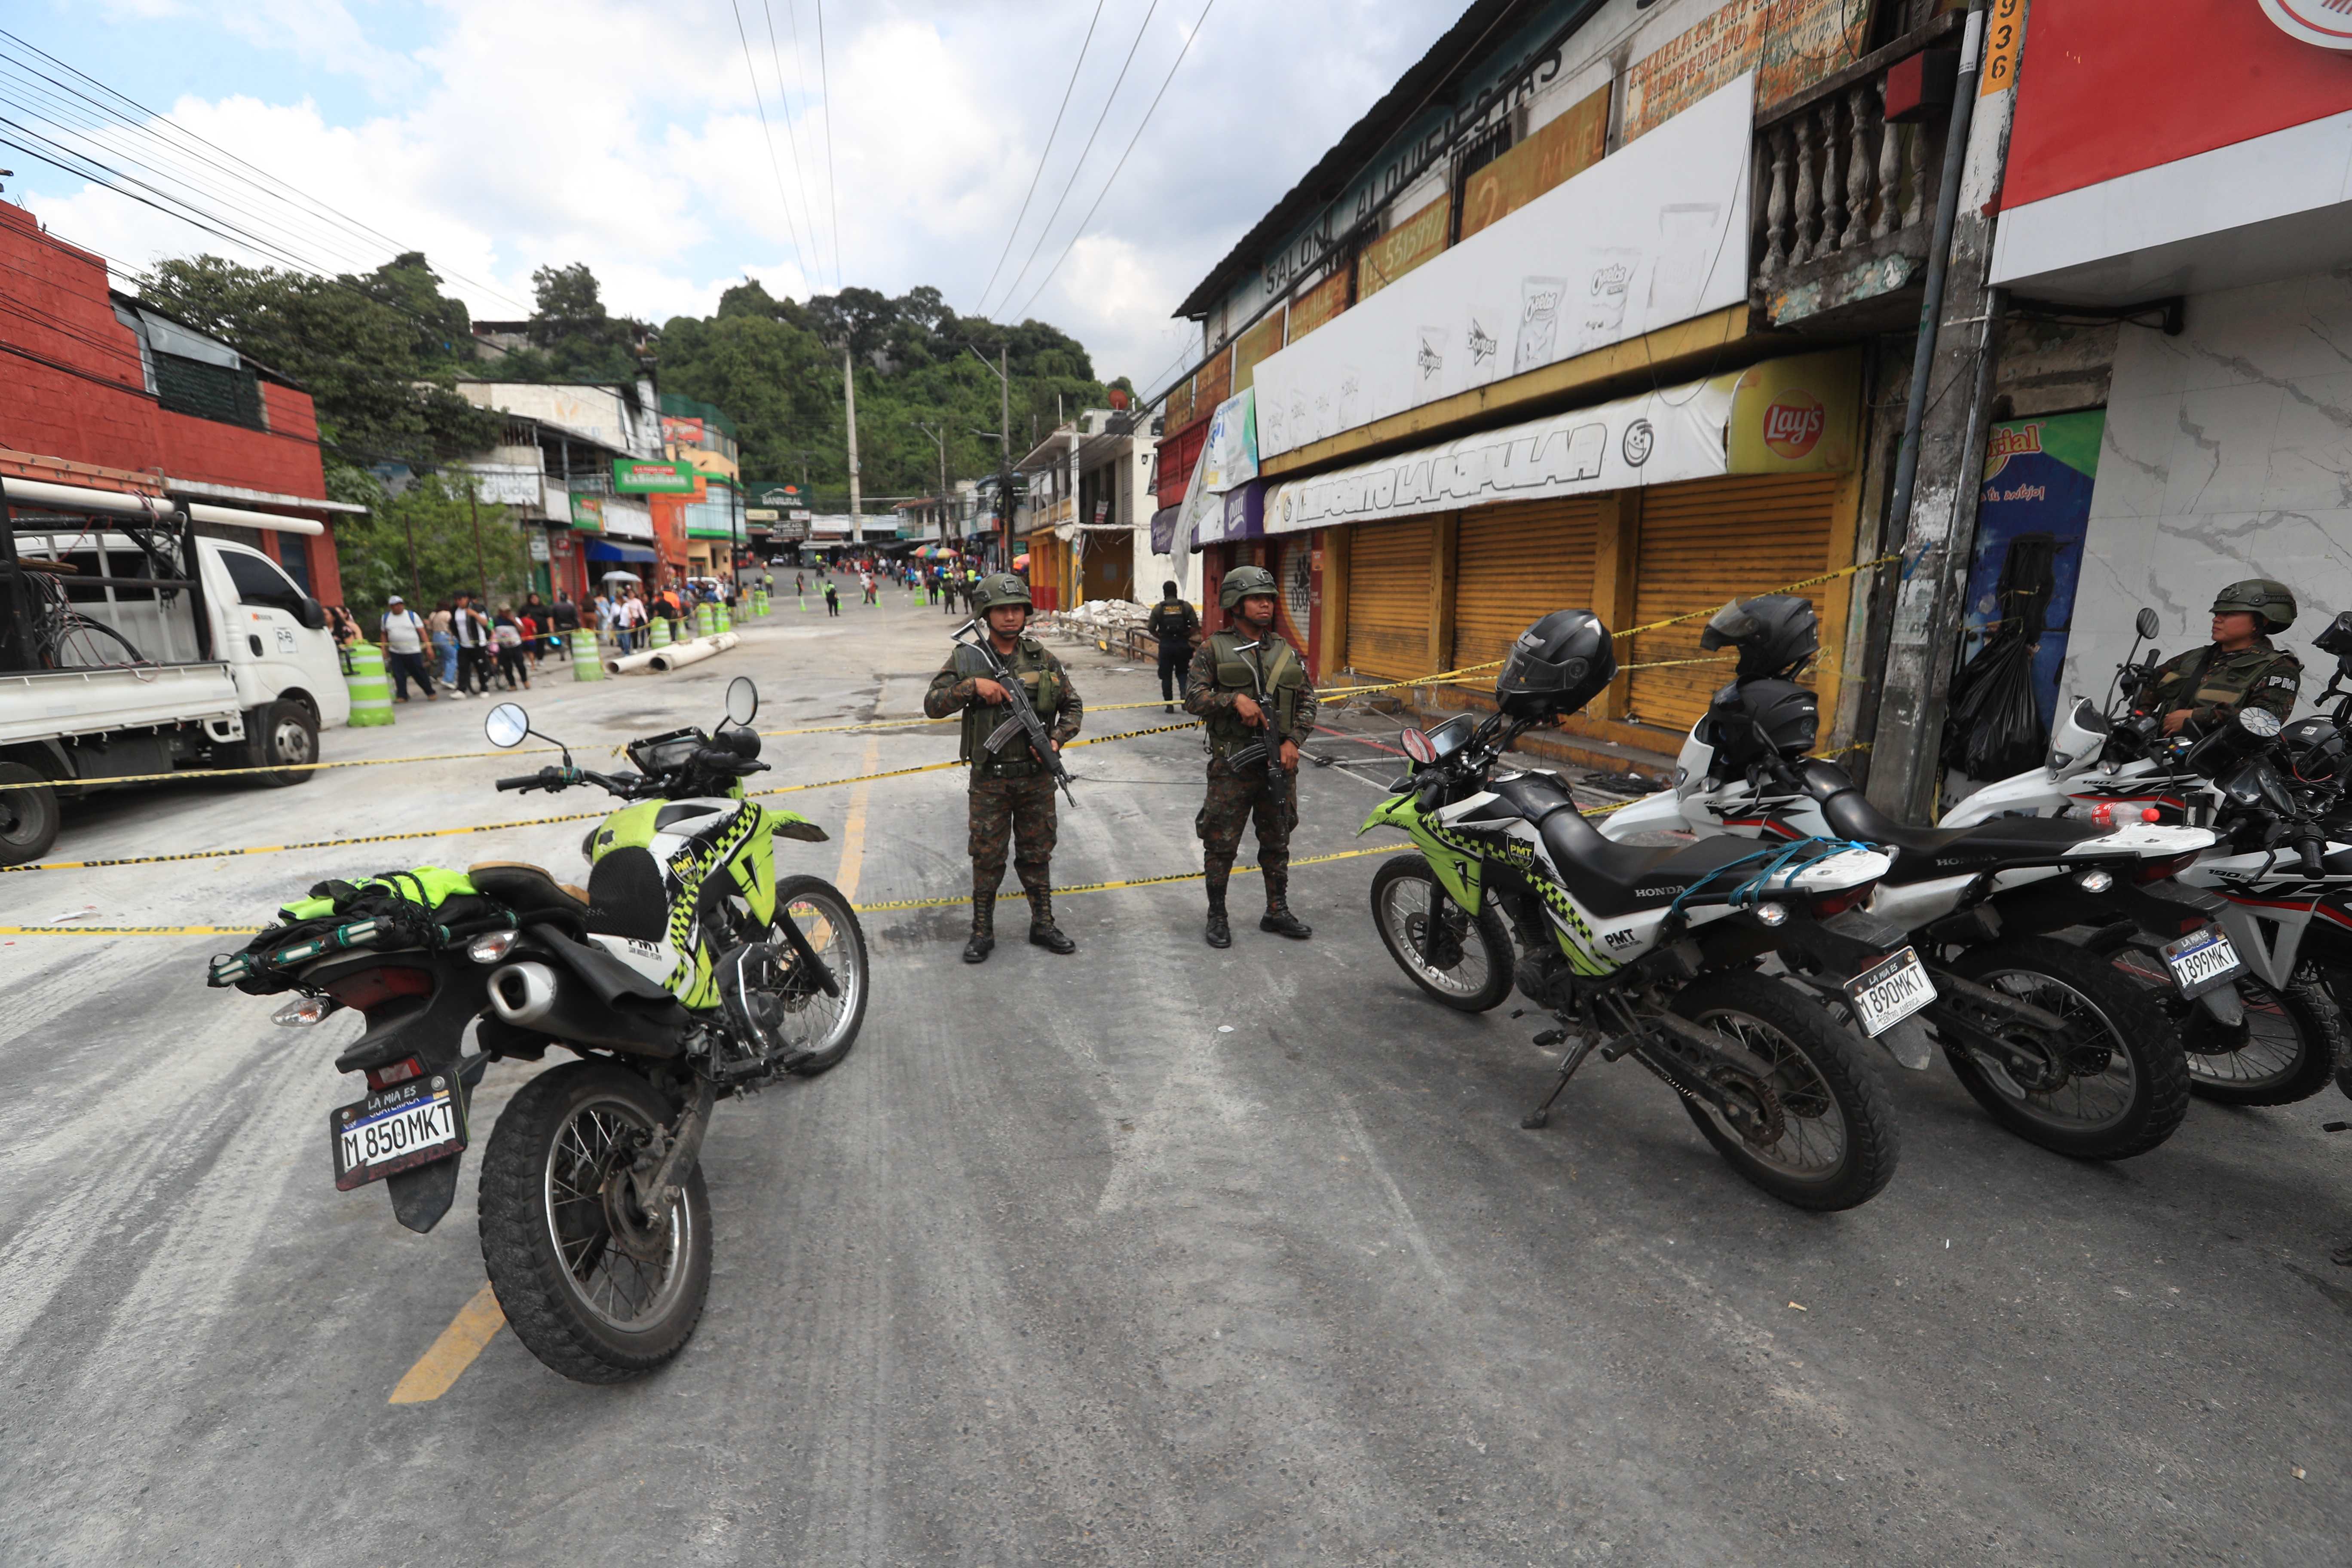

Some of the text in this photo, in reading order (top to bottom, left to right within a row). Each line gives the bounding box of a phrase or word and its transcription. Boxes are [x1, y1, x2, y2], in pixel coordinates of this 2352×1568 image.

[1767, 405, 1822, 444] Lay's
[2003, 483, 2045, 502] antojo!
[2269, 676, 2296, 691] PM
[1510, 844, 1532, 857] PMT
[672, 856, 694, 873] PMT
[1635, 885, 1686, 898] HONDA
[1604, 928, 1635, 947] PMT
[2181, 938, 2191, 947] LA
[2190, 934, 2202, 943] MIA
[2200, 930, 2209, 938] ES
[2185, 941, 2235, 979] 899MKT
[1868, 962, 1898, 986] LA MIA ES
[1859, 965, 1923, 1022] M 890MKT
[368, 1097, 382, 1111] LA
[384, 1090, 401, 1106] MIA
[404, 1085, 417, 1098] ES
[344, 1133, 361, 1167] M
[365, 1100, 452, 1158] 850MKT
